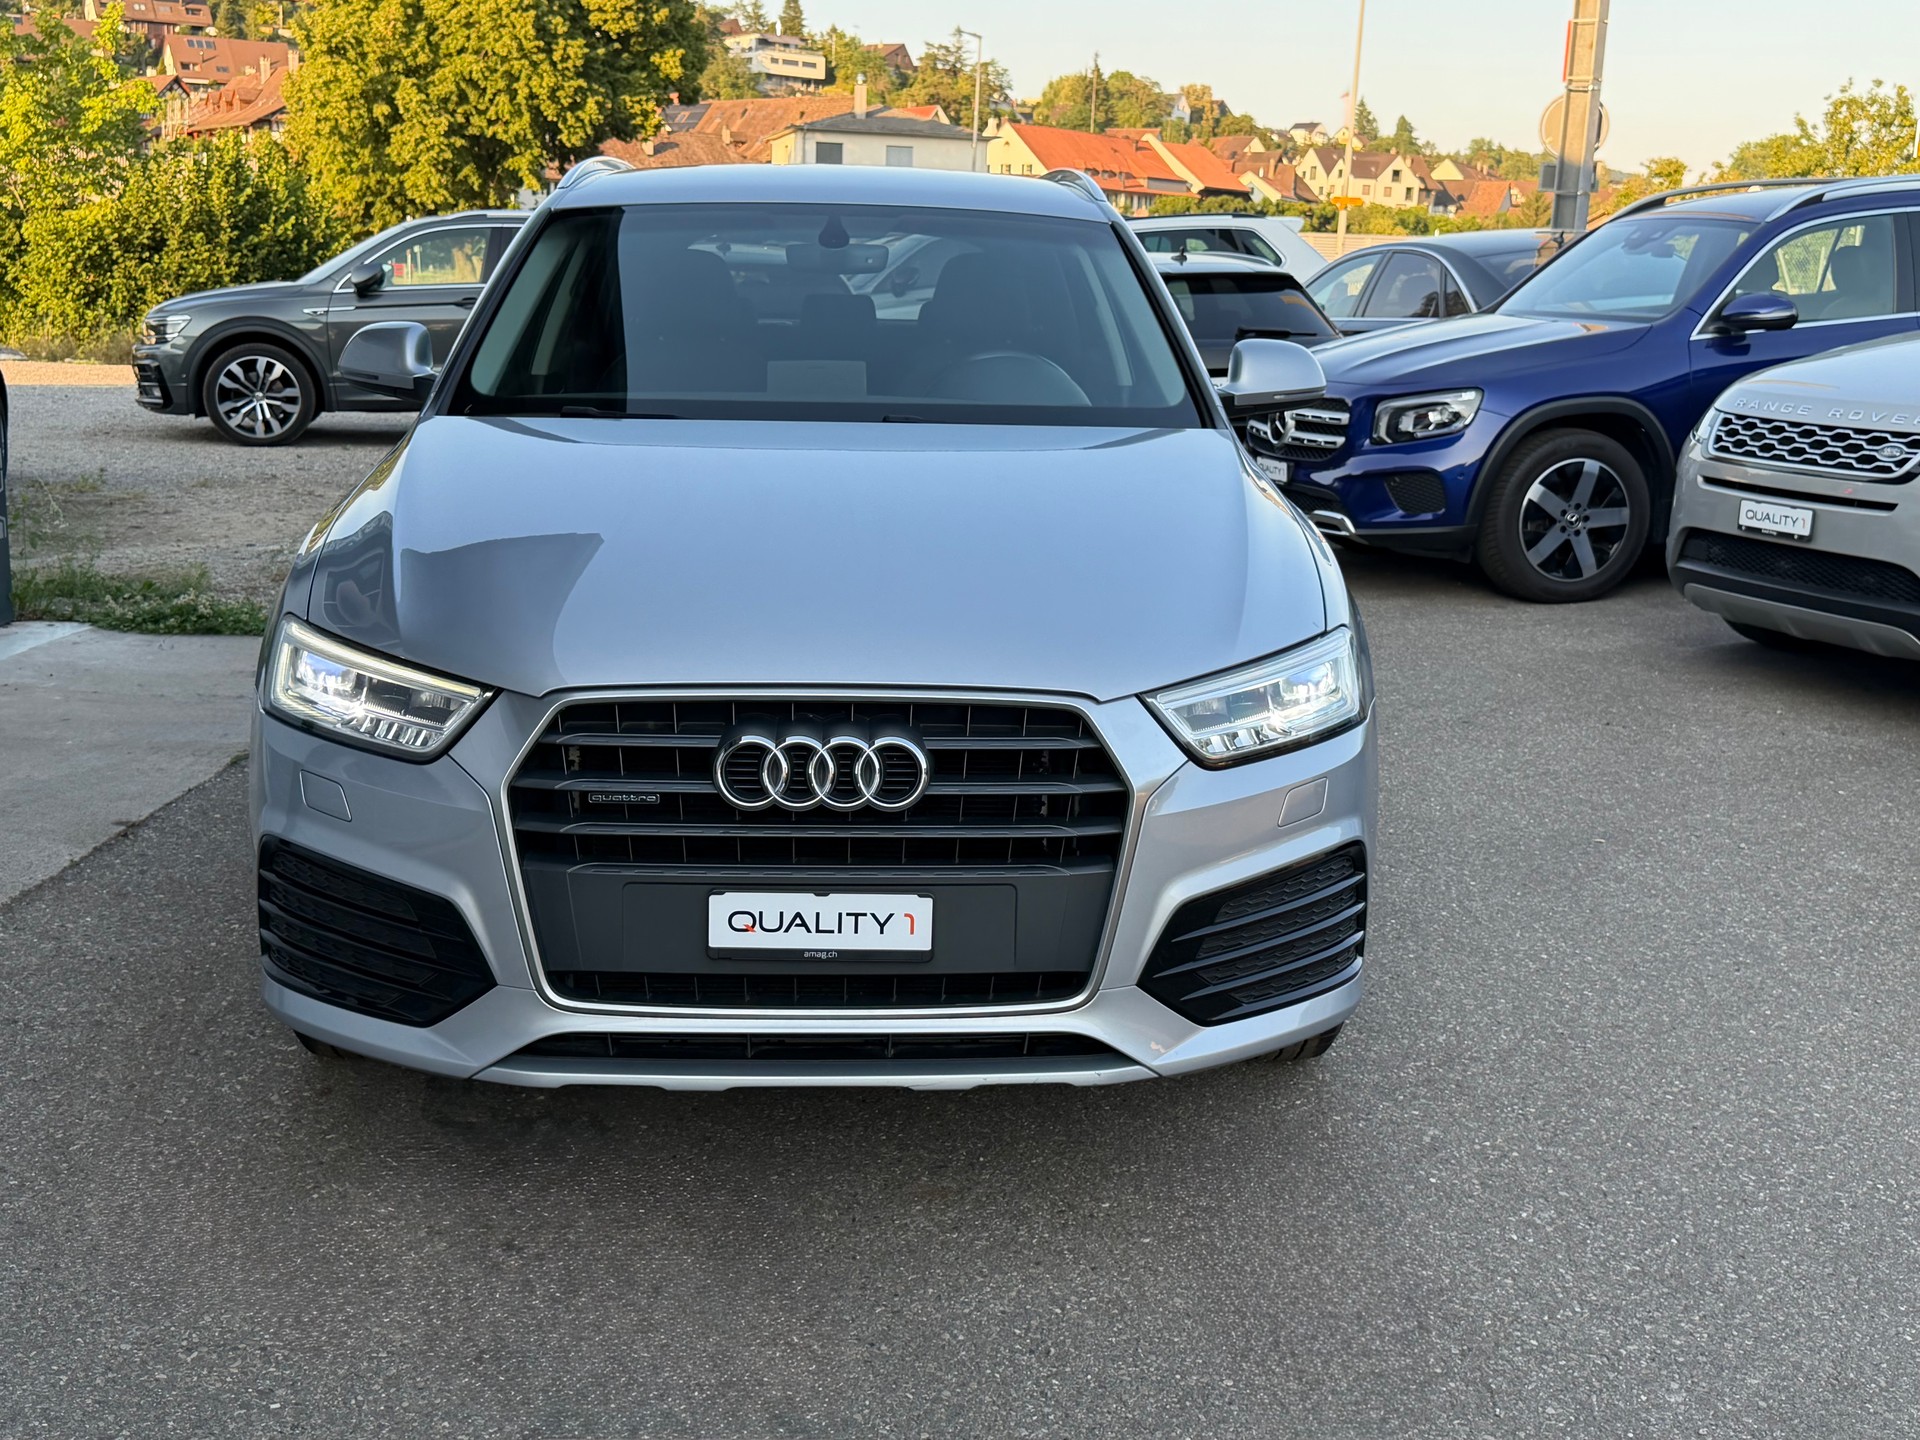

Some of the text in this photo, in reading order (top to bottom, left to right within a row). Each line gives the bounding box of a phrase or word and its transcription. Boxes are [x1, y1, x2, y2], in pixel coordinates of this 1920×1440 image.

[1735, 397, 1812, 416] RANGE
[1745, 509, 1807, 529] QUALITY 1
[592, 794, 657, 802] quattro
[728, 910, 915, 935] QUALITY 1
[803, 950, 838, 960] amag.ch
